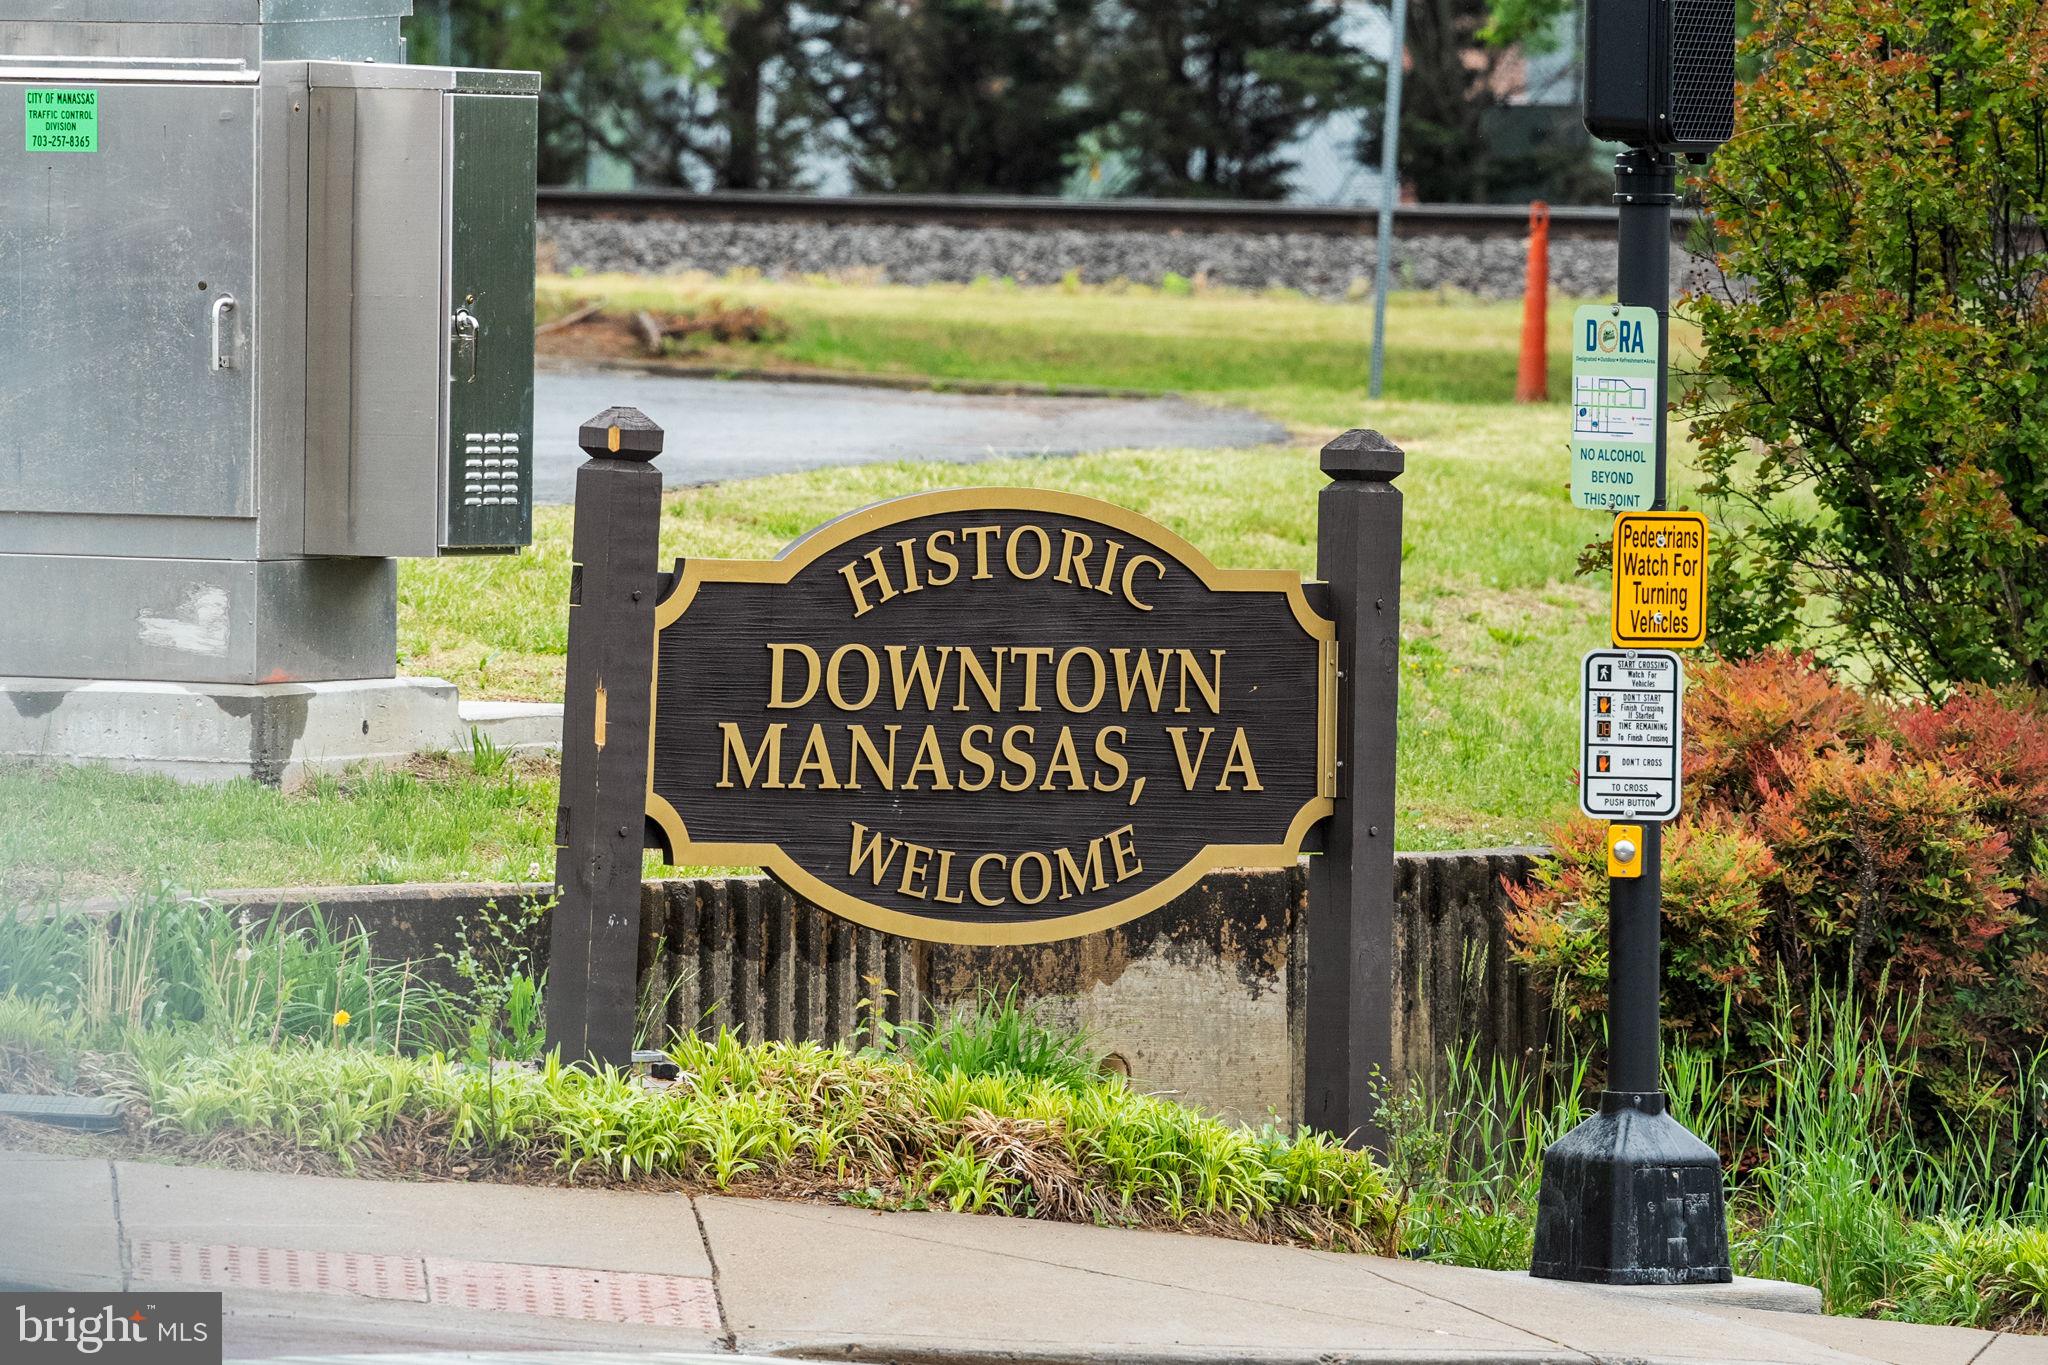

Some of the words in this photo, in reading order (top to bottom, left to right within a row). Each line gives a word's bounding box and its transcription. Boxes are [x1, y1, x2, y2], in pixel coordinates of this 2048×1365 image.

[27, 92, 43, 104] CITY
[45, 92, 54, 104] OF
[57, 93, 95, 105] MANASSAS
[29, 110, 58, 119] TRAFFIC
[60, 110, 94, 120] CONTROL
[45, 122, 77, 131] DIVISION
[32, 135, 90, 148] 703-257-8365
[1586, 319, 1645, 354] DORA
[1580, 448, 1595, 460] NO
[1597, 449, 1646, 463] ALCOHOL
[1591, 470, 1633, 484] BEYOND
[1584, 492, 1607, 506] THIS
[1609, 493, 1640, 507] POINT
[1624, 524, 1698, 549] Pedestrians
[837, 524, 1166, 618] HISTORIC
[1624, 552, 1668, 576] Watch
[1673, 553, 1698, 577] For
[1633, 581, 1688, 611] Turning
[1630, 609, 1689, 633] Vehicles
[1617, 660, 1636, 669] START
[1638, 660, 1669, 670] CROSSING
[766, 643, 1226, 715] DOWNTOWN
[1627, 671, 1645, 679] Watch
[1647, 671, 1657, 679] For
[1631, 680, 1656, 688] Vehicles
[1622, 693, 1641, 702] DON'T
[1643, 694, 1662, 703] START
[1620, 703, 1638, 712] Finish
[1640, 704, 1664, 715] Crossing
[1635, 712, 1655, 720] Started
[1618, 722, 1632, 731] TIME
[1635, 723, 1668, 732] REMAINING
[1617, 733, 1625, 741] To
[1627, 734, 1643, 742] Finish
[1646, 735, 1669, 744] Crossing
[716, 722, 1148, 805] MANASSAS,
[1166, 726, 1264, 791] VA
[1621, 758, 1640, 767] DON'T
[1642, 758, 1663, 767] CROSS
[1612, 783, 1621, 792] TO
[1623, 783, 1649, 793] CROSS
[1604, 798, 1625, 807] PUSH
[1627, 799, 1656, 808] BUTTON
[849, 821, 1144, 907] WELCOME
